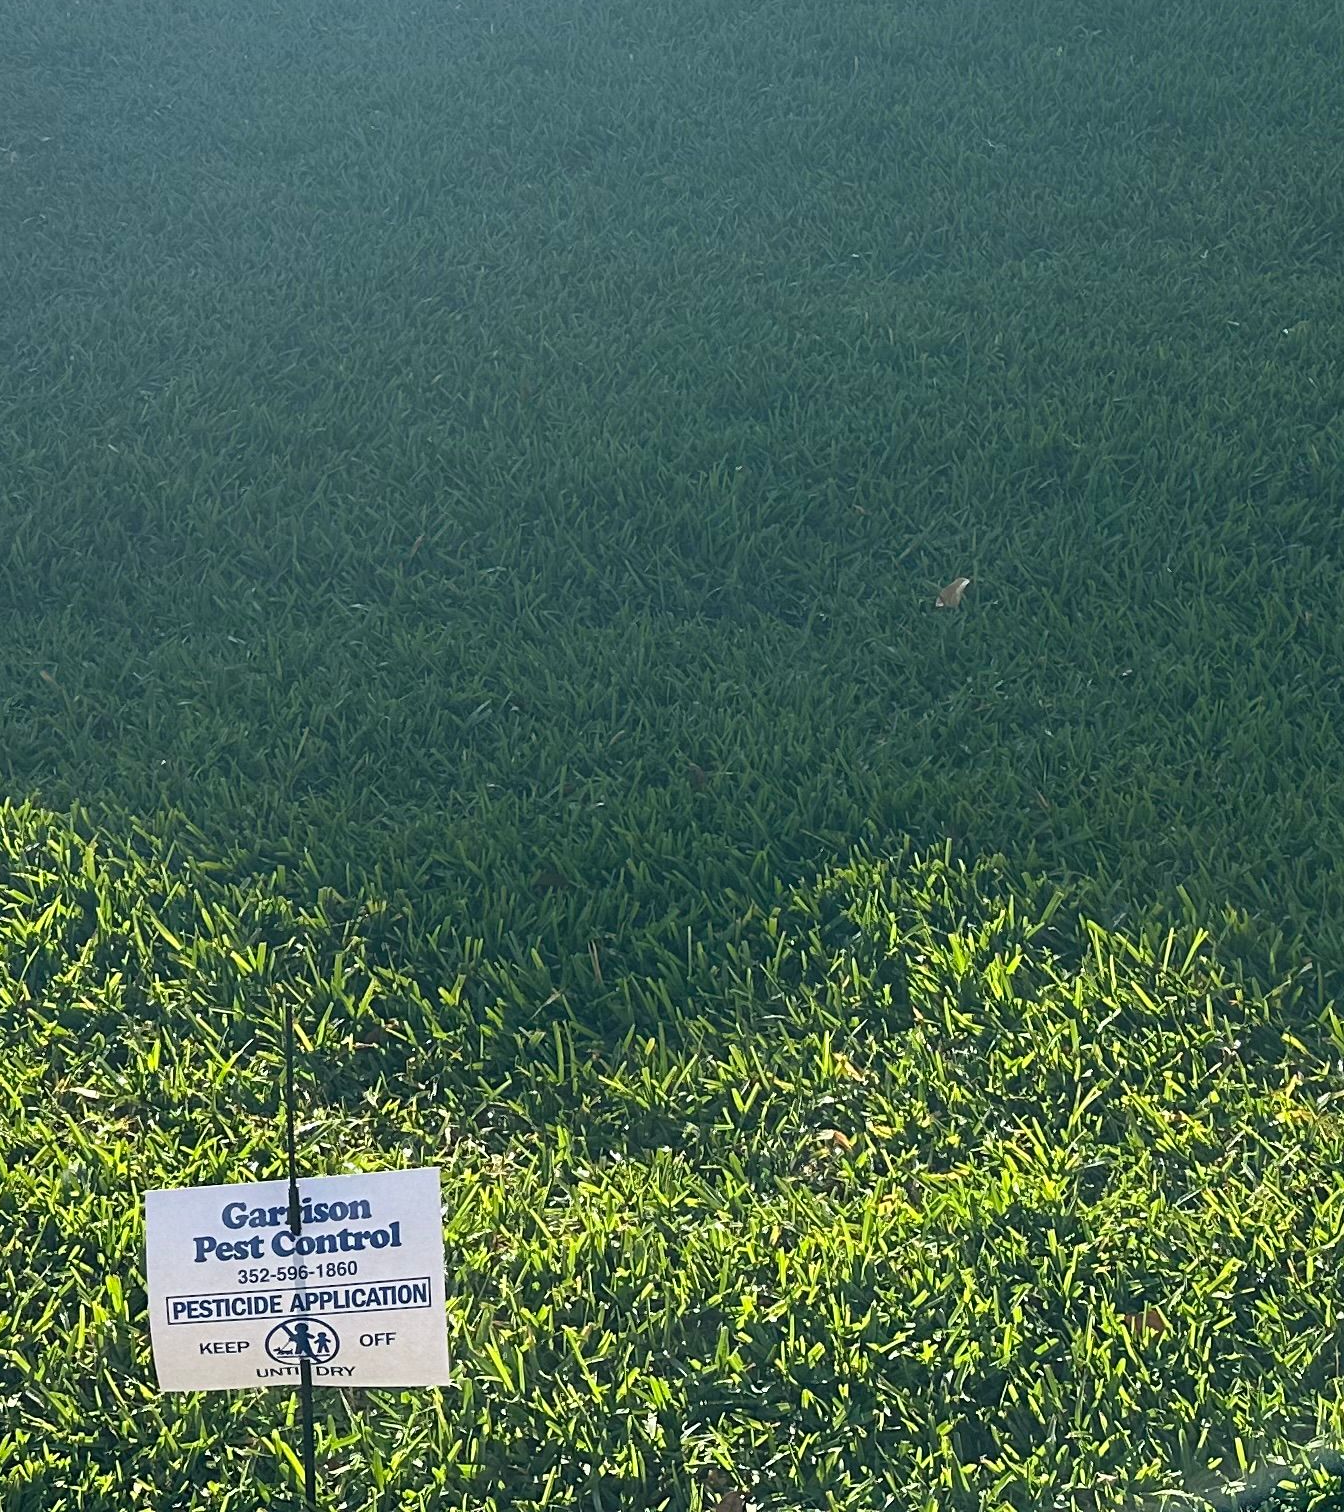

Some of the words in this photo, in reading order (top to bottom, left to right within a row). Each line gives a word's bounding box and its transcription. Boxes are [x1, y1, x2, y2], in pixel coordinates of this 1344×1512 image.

[193, 1236, 265, 1263] Pest
[271, 1222, 402, 1257] Control
[238, 1261, 358, 1284] 352-596-1860
[172, 1294, 283, 1321] PESTICIDE
[289, 1283, 427, 1313] APPLICATION
[199, 1341, 250, 1355] KEEP
[359, 1332, 397, 1347] OFF
[256, 1367, 299, 1378] UNTI
[316, 1366, 356, 1377] DRY
